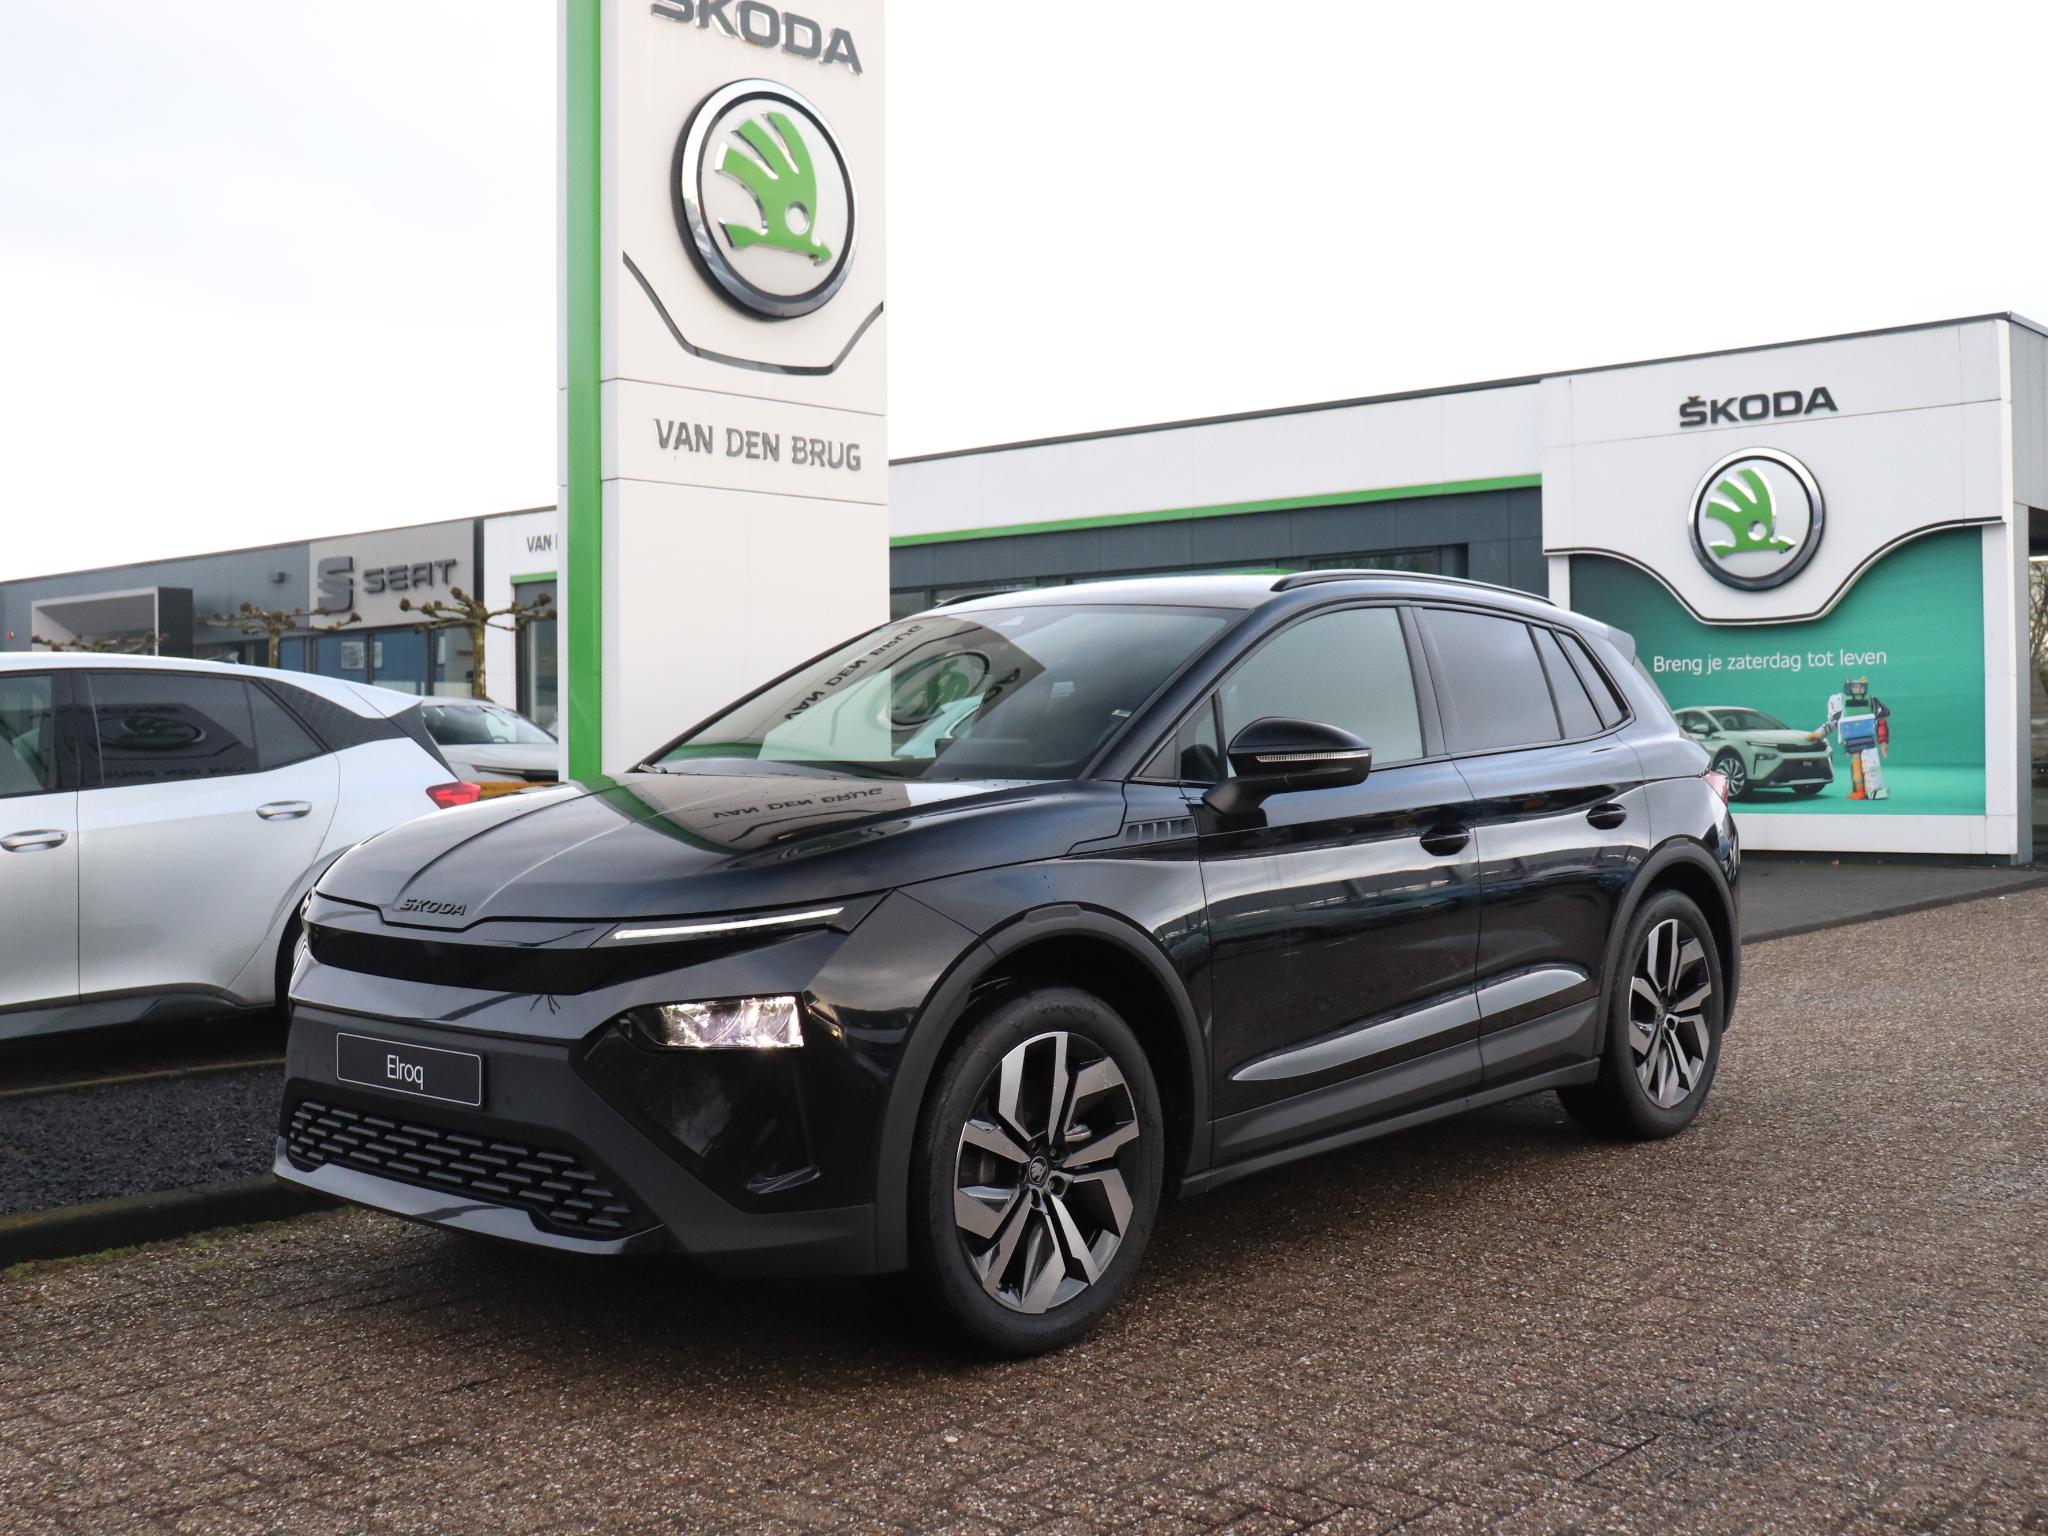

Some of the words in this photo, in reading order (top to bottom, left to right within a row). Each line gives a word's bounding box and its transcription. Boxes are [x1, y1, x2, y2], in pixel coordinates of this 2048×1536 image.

[1679, 386, 1839, 428] ŠKODA
[653, 418, 714, 455] VAN
[725, 427, 781, 462] DEN
[791, 435, 862, 472] BRUG
[526, 534, 552, 552] VAN
[363, 558, 458, 594] SEAT
[1653, 656, 1702, 676] Breng
[1706, 654, 1722, 675] je
[1727, 651, 1802, 673] zaterdag
[1807, 651, 1834, 668] tot
[1840, 649, 1888, 666] leven
[387, 1054, 424, 1091] Elroq
